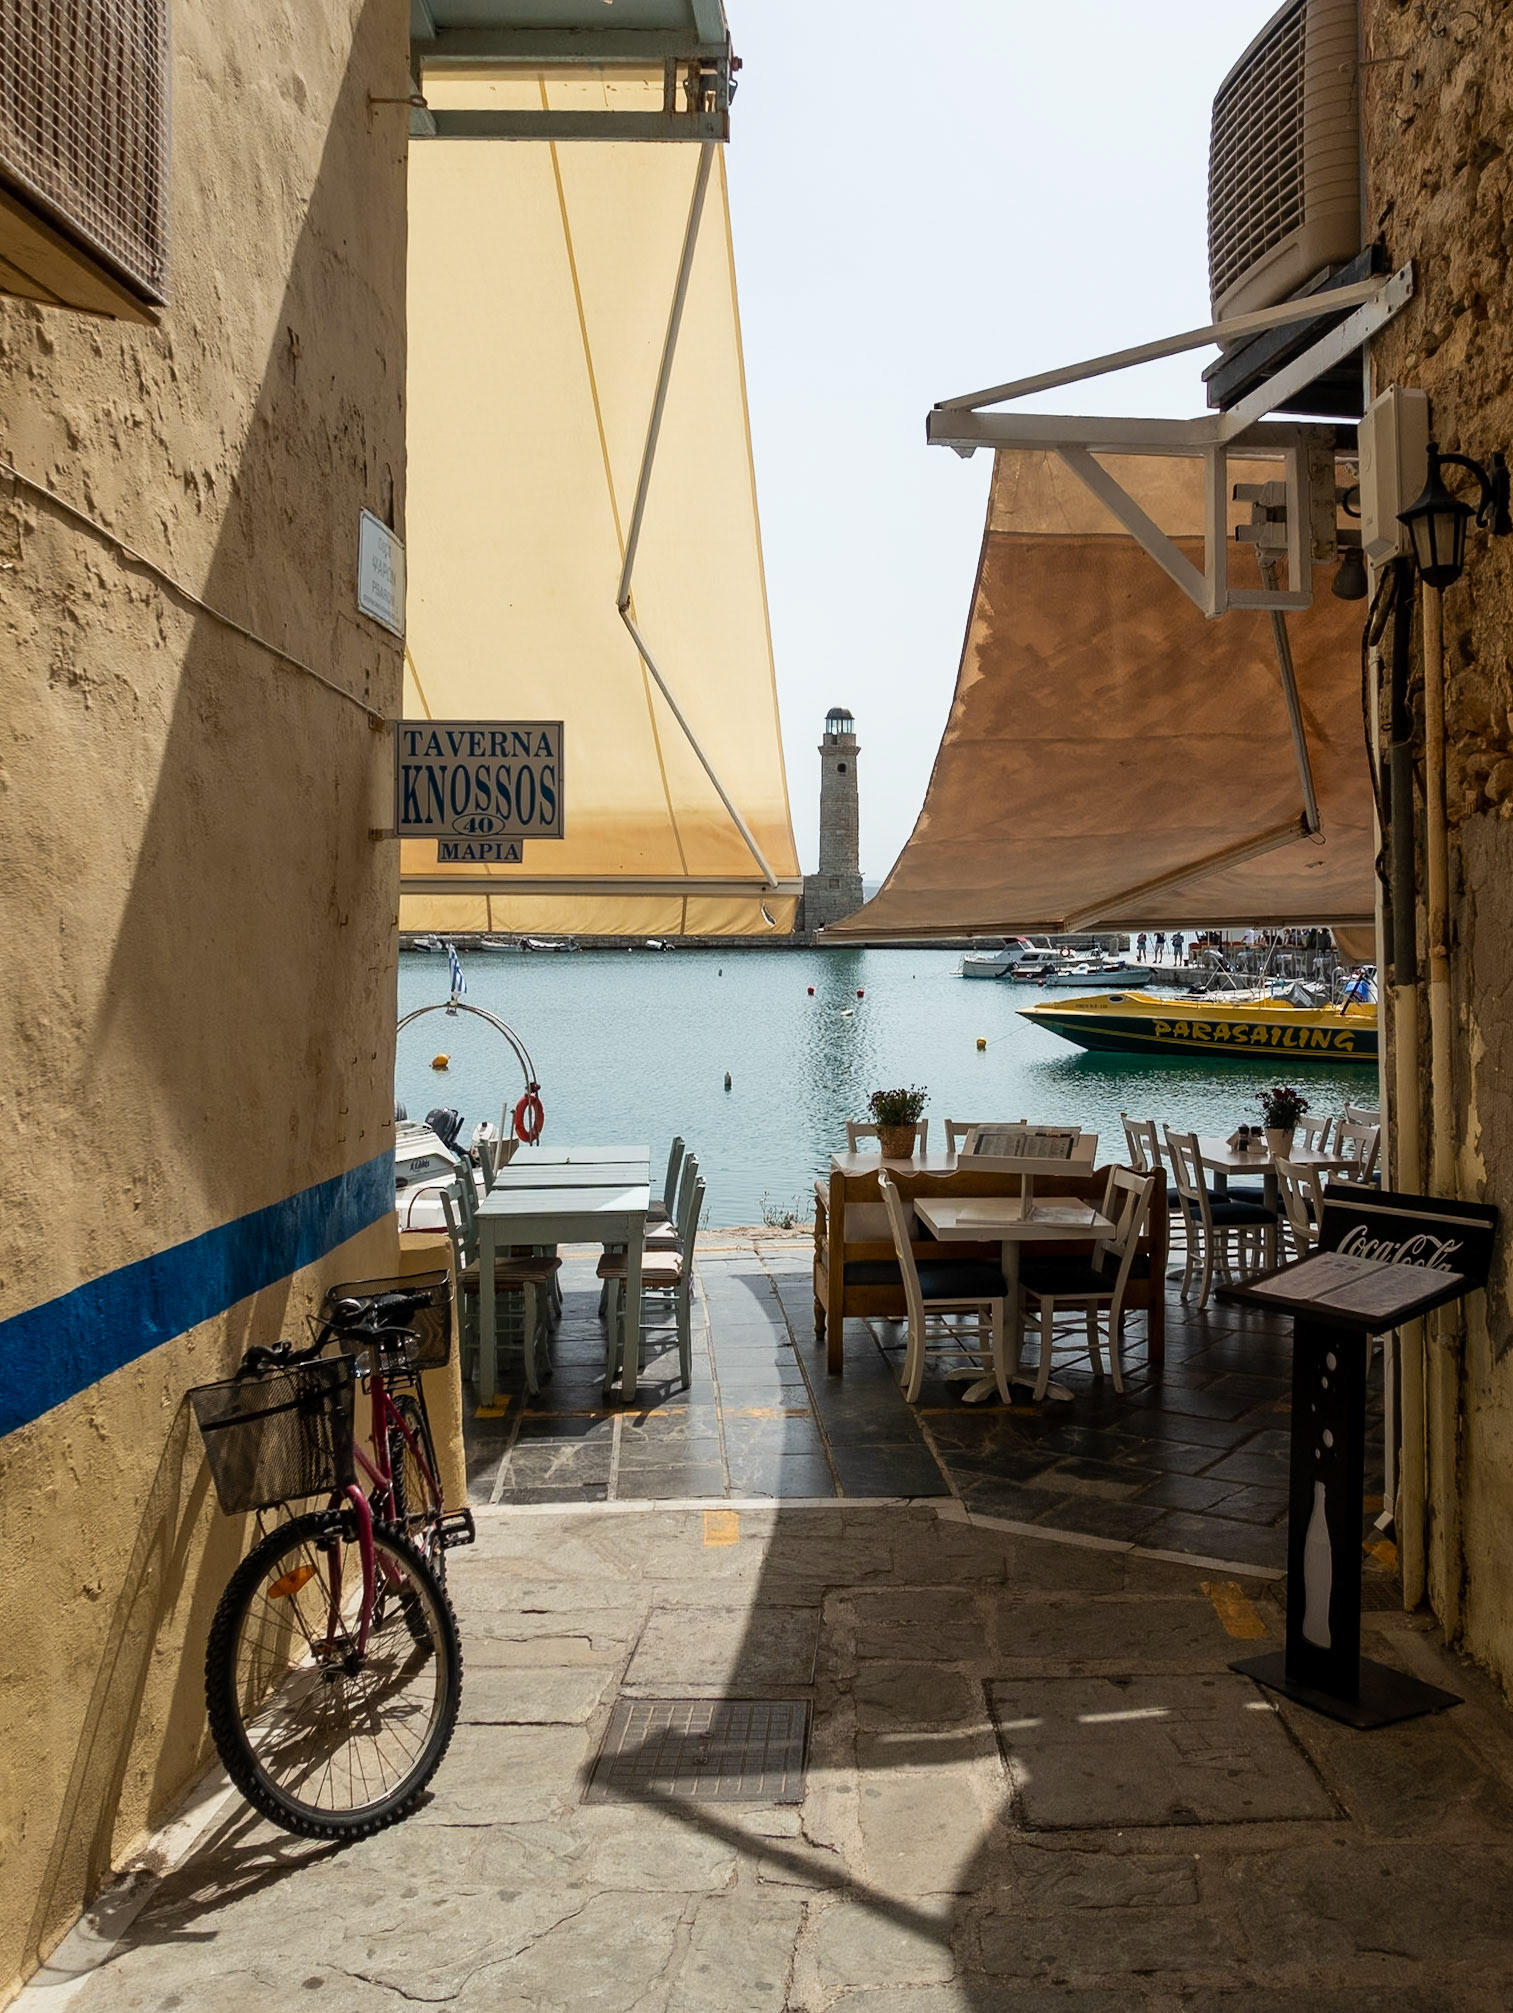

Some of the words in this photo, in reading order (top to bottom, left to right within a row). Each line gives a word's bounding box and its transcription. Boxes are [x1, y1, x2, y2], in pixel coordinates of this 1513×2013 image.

[403, 730, 555, 758] TAVERNA
[401, 763, 557, 826] KNOSSOS
[462, 816, 494, 835] 40
[1152, 1018, 1356, 1053] PARASAILING
